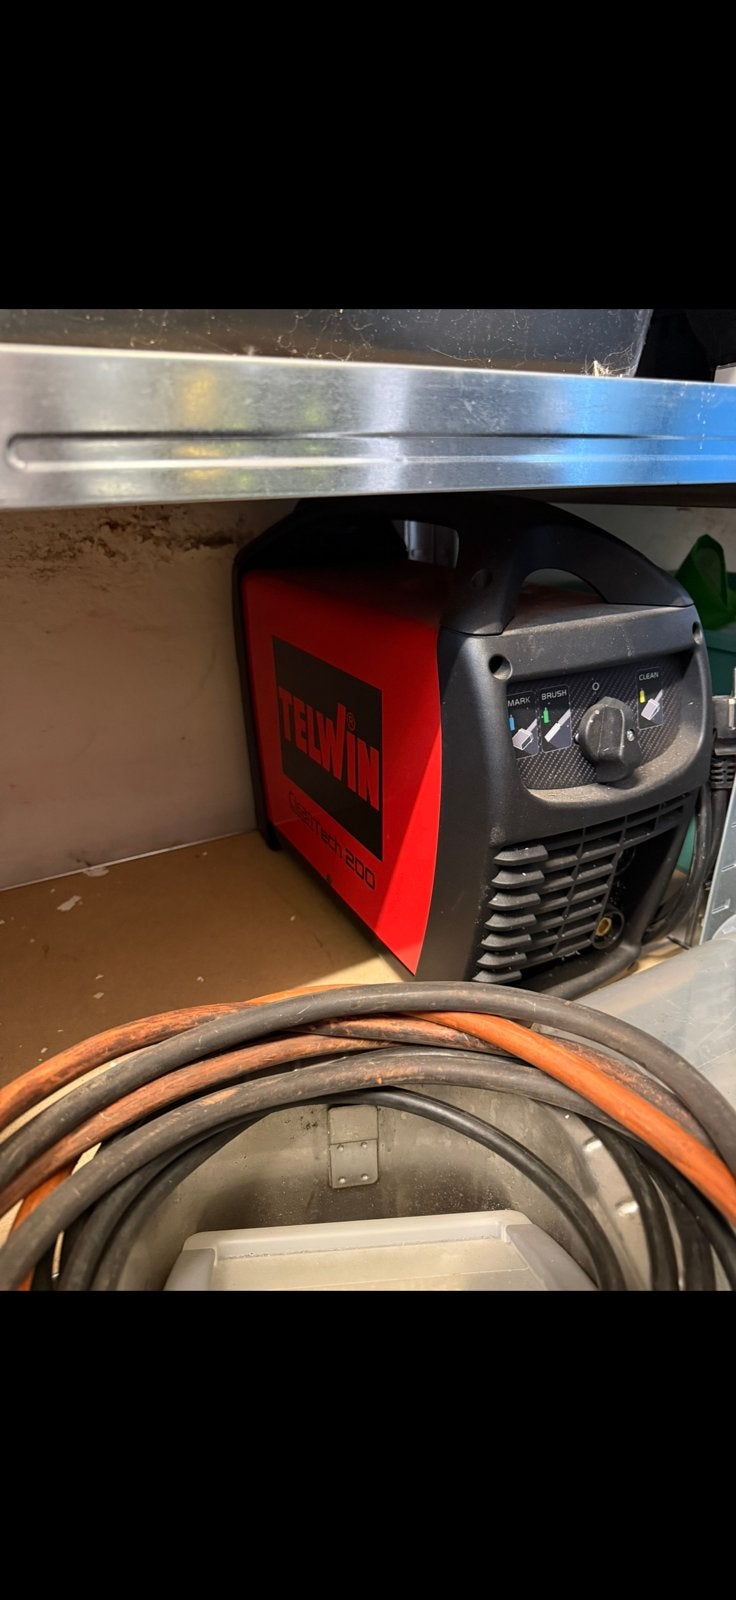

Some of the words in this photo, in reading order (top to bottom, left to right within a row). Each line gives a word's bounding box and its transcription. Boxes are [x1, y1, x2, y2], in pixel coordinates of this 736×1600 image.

[638, 671, 659, 681] CLEAN
[541, 689, 567, 701] BRUSH
[507, 696, 531, 707] MARK
[278, 686, 380, 811] TELWIN
[345, 848, 375, 890] 200
